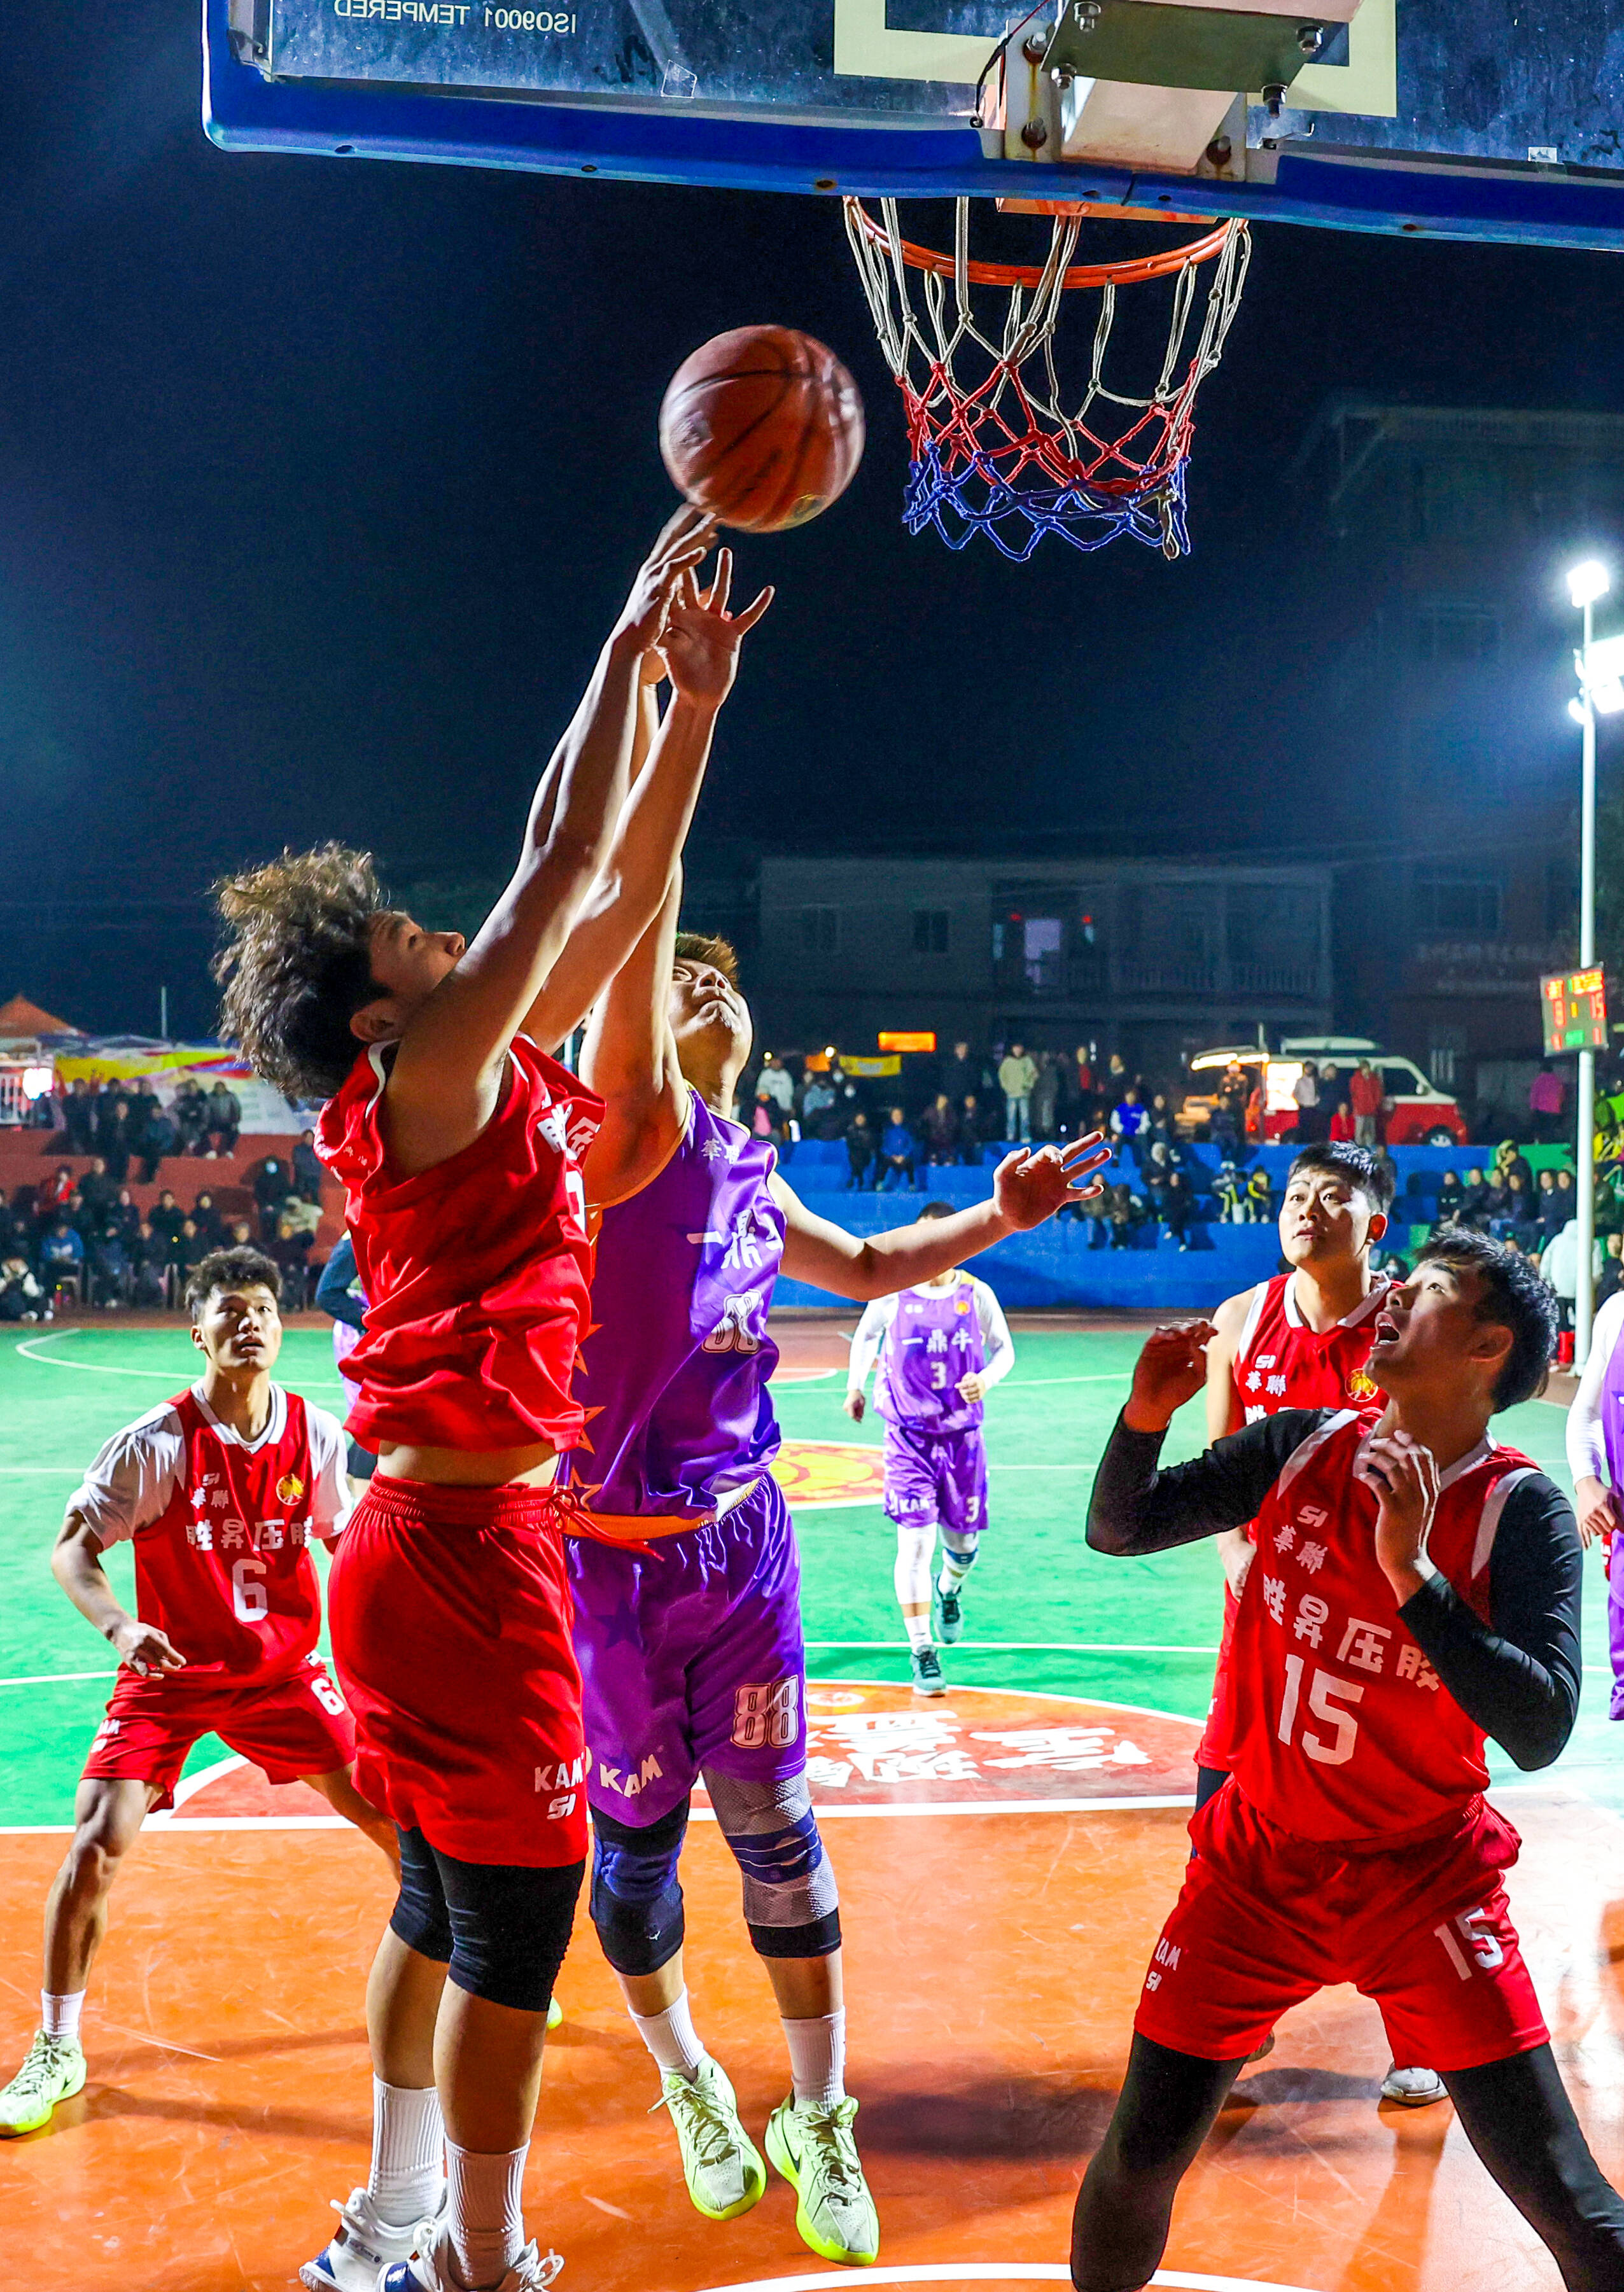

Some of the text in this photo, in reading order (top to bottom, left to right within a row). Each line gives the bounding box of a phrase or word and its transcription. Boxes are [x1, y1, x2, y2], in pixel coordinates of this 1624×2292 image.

[901, 1327, 974, 1353] 一鼎牛
[930, 1360, 948, 1390] 3
[965, 1495, 981, 1524] 3
[232, 1558, 269, 1623] 6
[311, 1677, 345, 1716] 6
[730, 1674, 799, 1749] 88
[1278, 1653, 1365, 1766] 15
[534, 1756, 584, 1793] KAM
[600, 1754, 663, 1798] KAM
[1433, 1904, 1504, 1981] 15
